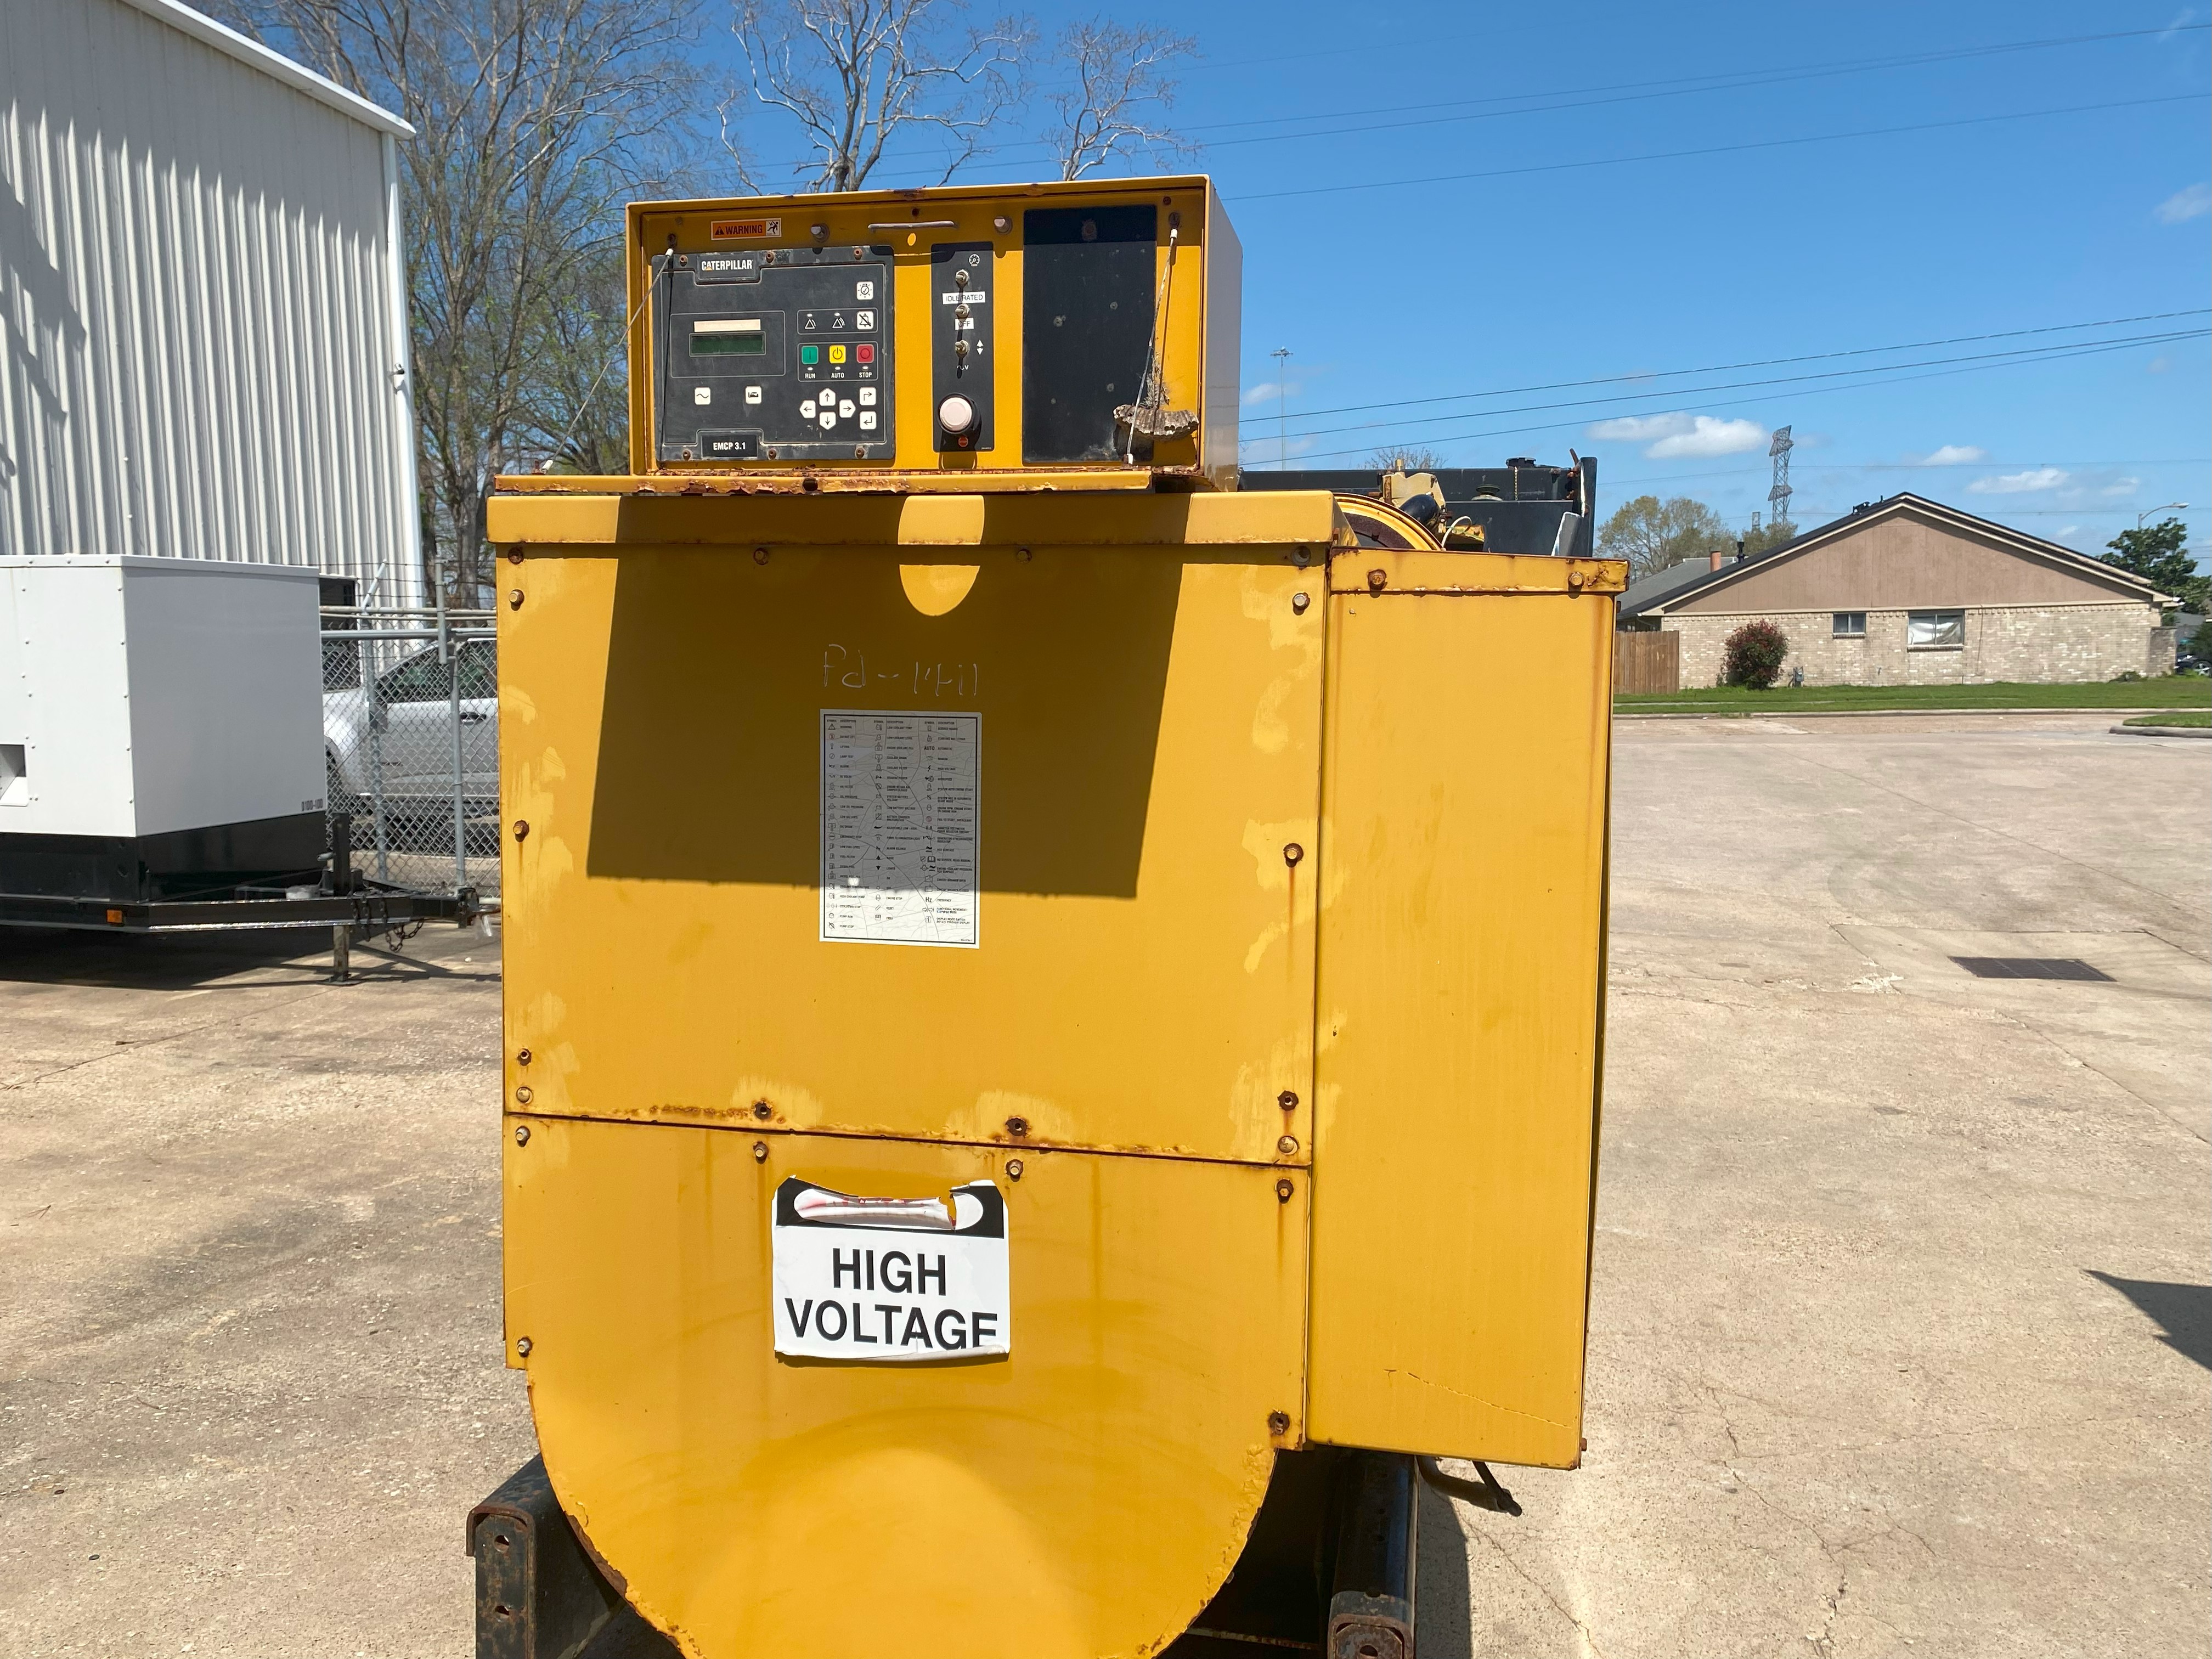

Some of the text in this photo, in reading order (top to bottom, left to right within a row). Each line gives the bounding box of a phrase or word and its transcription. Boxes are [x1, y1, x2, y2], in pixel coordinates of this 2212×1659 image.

[726, 224, 763, 234] WARNING
[701, 259, 752, 271] CATERPILLAR
[713, 442, 746, 451] EMCP 3.1
[832, 1248, 946, 1296] HIGH
